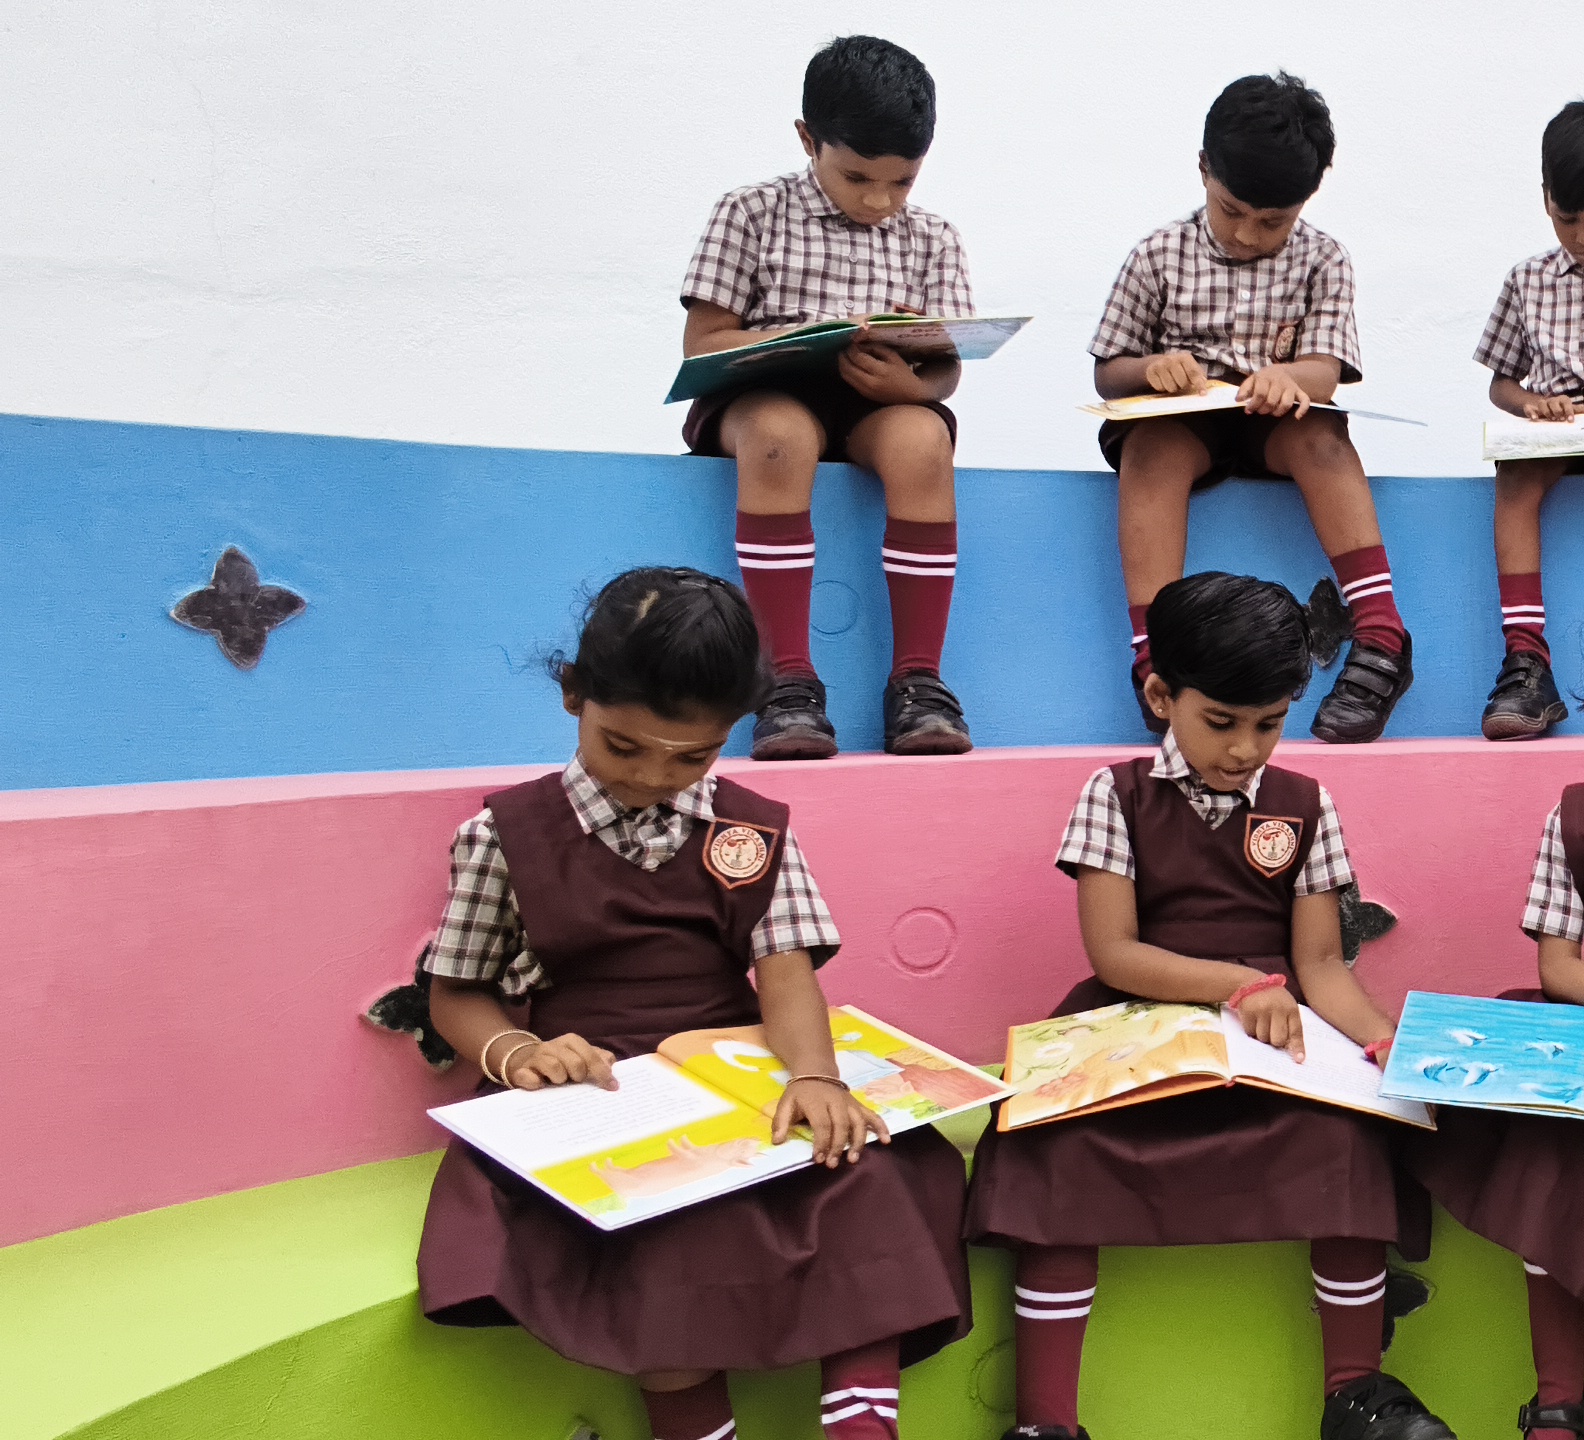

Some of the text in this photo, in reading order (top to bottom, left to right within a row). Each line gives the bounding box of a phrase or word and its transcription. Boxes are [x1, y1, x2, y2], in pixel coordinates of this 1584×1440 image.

[712, 828, 766, 862] VIDHYA VIKASHNI
[1252, 821, 1295, 850] VIDHYA VIKASHNI
